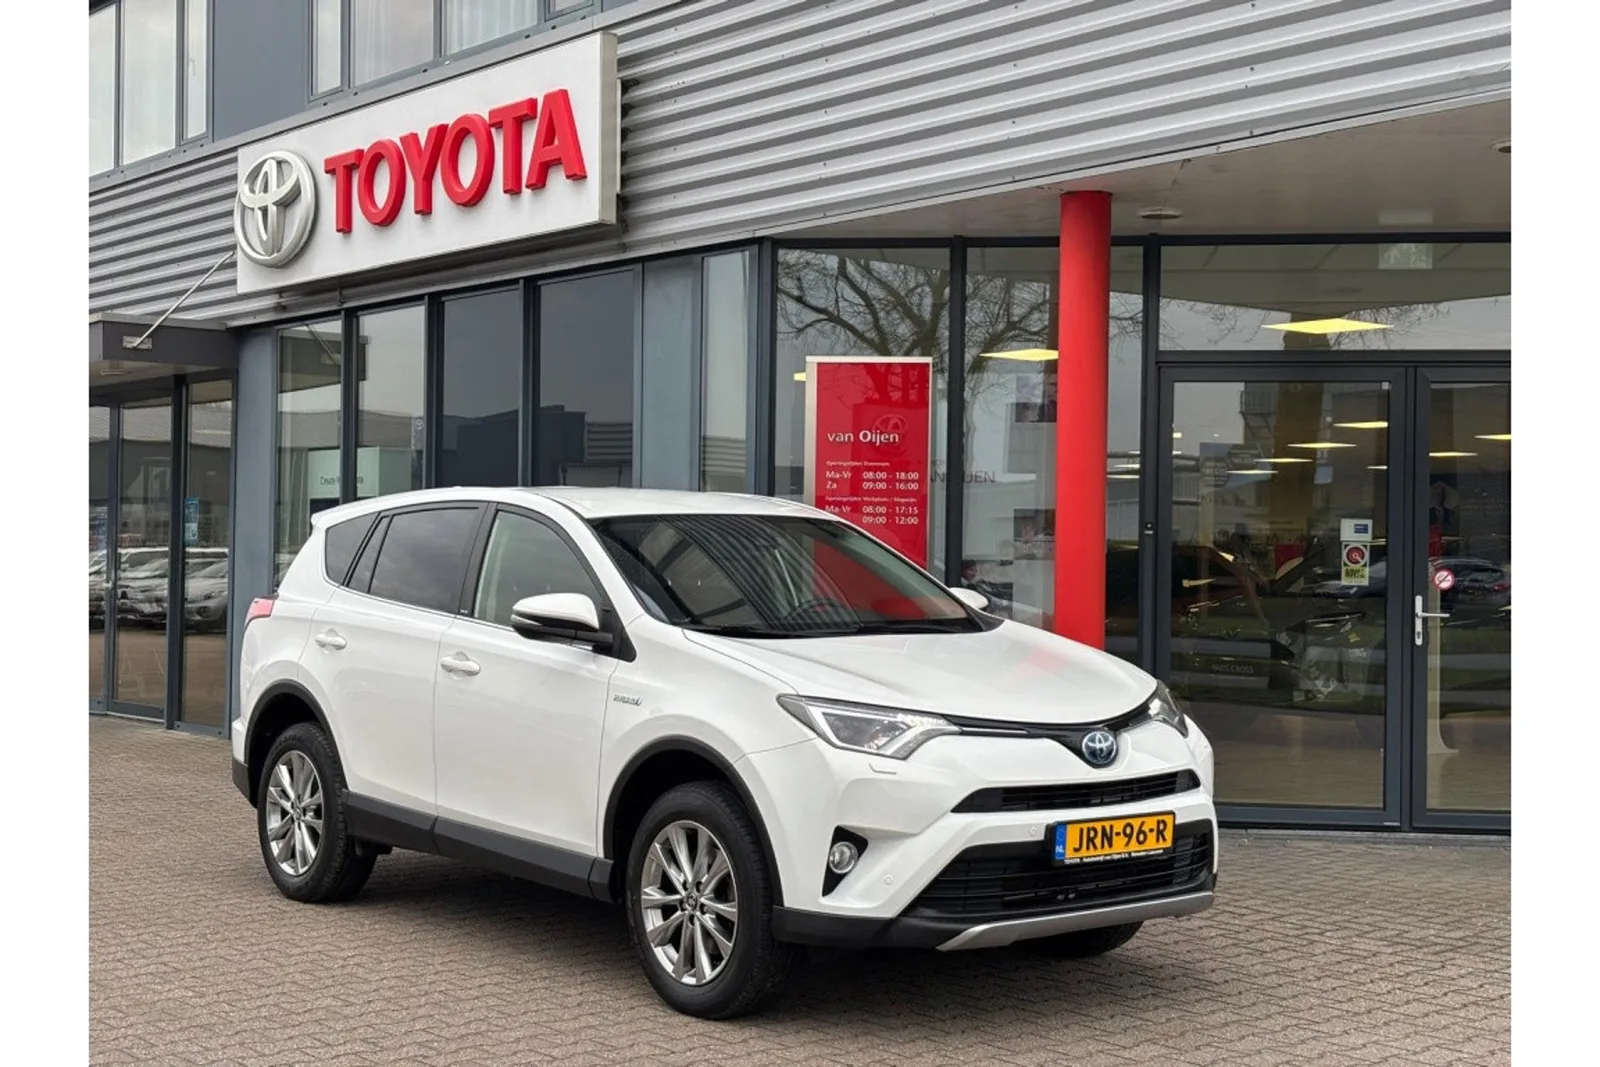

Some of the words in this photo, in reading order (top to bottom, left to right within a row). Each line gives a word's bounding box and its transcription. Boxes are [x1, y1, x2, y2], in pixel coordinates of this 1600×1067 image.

[324, 88, 587, 233] TOYOTA
[827, 432, 854, 443] van
[859, 429, 899, 447] Oijen
[825, 470, 851, 479] Ma-Vr
[862, 471, 887, 479] 08:00
[895, 471, 919, 480] 18:00
[826, 481, 837, 489] Za
[862, 481, 887, 490] 09:00
[895, 482, 919, 490] 16:00
[862, 505, 887, 513] 08:00
[895, 506, 919, 514] 17:15
[862, 516, 887, 524] 09:00
[895, 516, 919, 525] 12:00
[1055, 845, 1064, 853] NL
[1073, 819, 1168, 853] JRN-96-R
